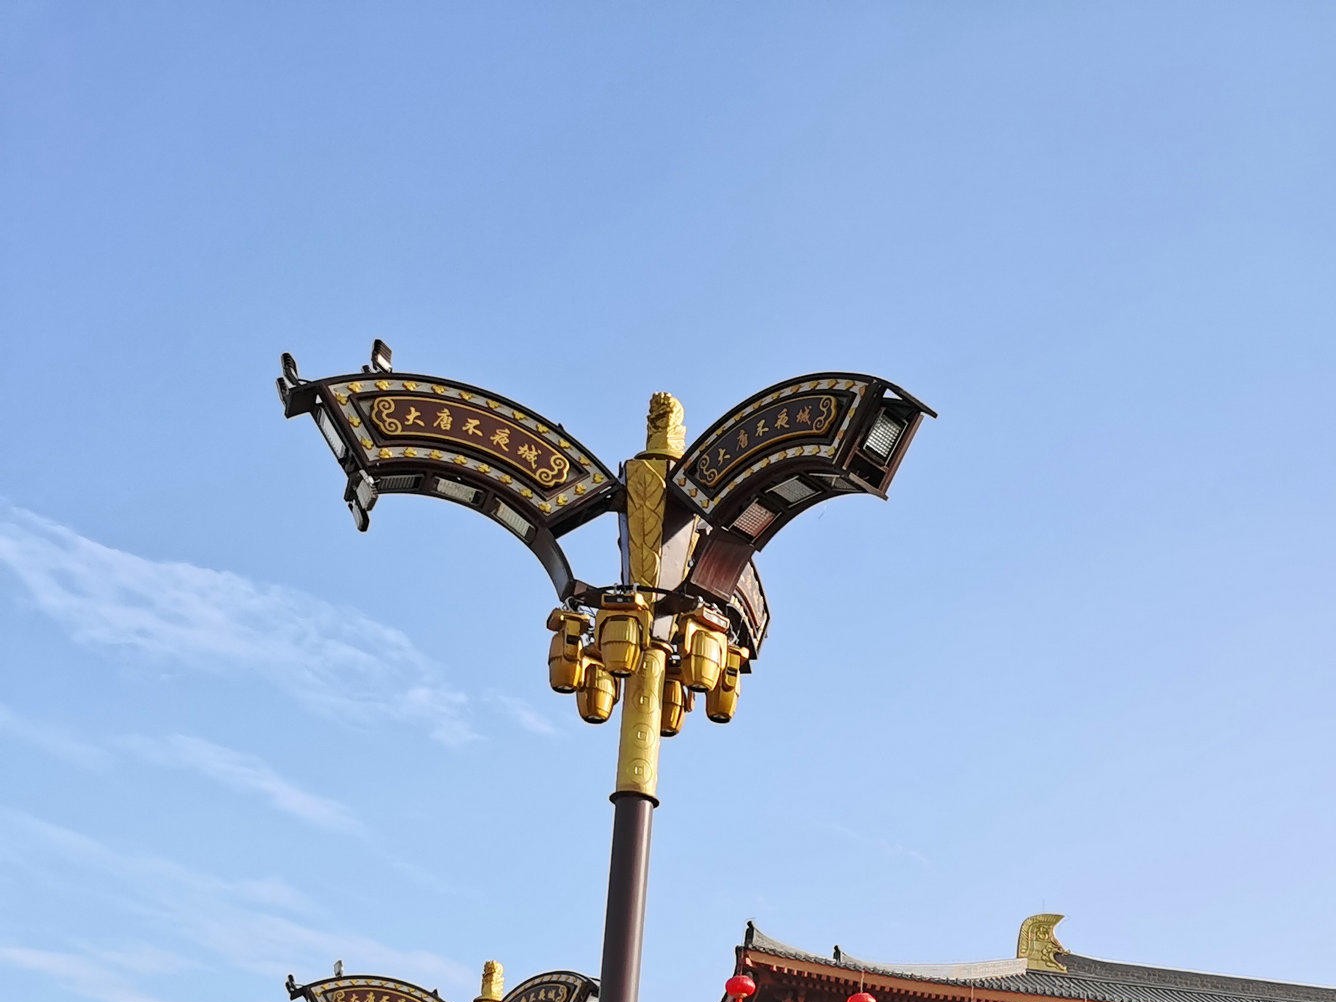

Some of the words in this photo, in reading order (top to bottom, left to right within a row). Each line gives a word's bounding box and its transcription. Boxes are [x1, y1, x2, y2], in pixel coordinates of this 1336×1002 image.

[404, 406, 542, 469] 大唐不夜城
[718, 405, 812, 466] 大唐不夜城
